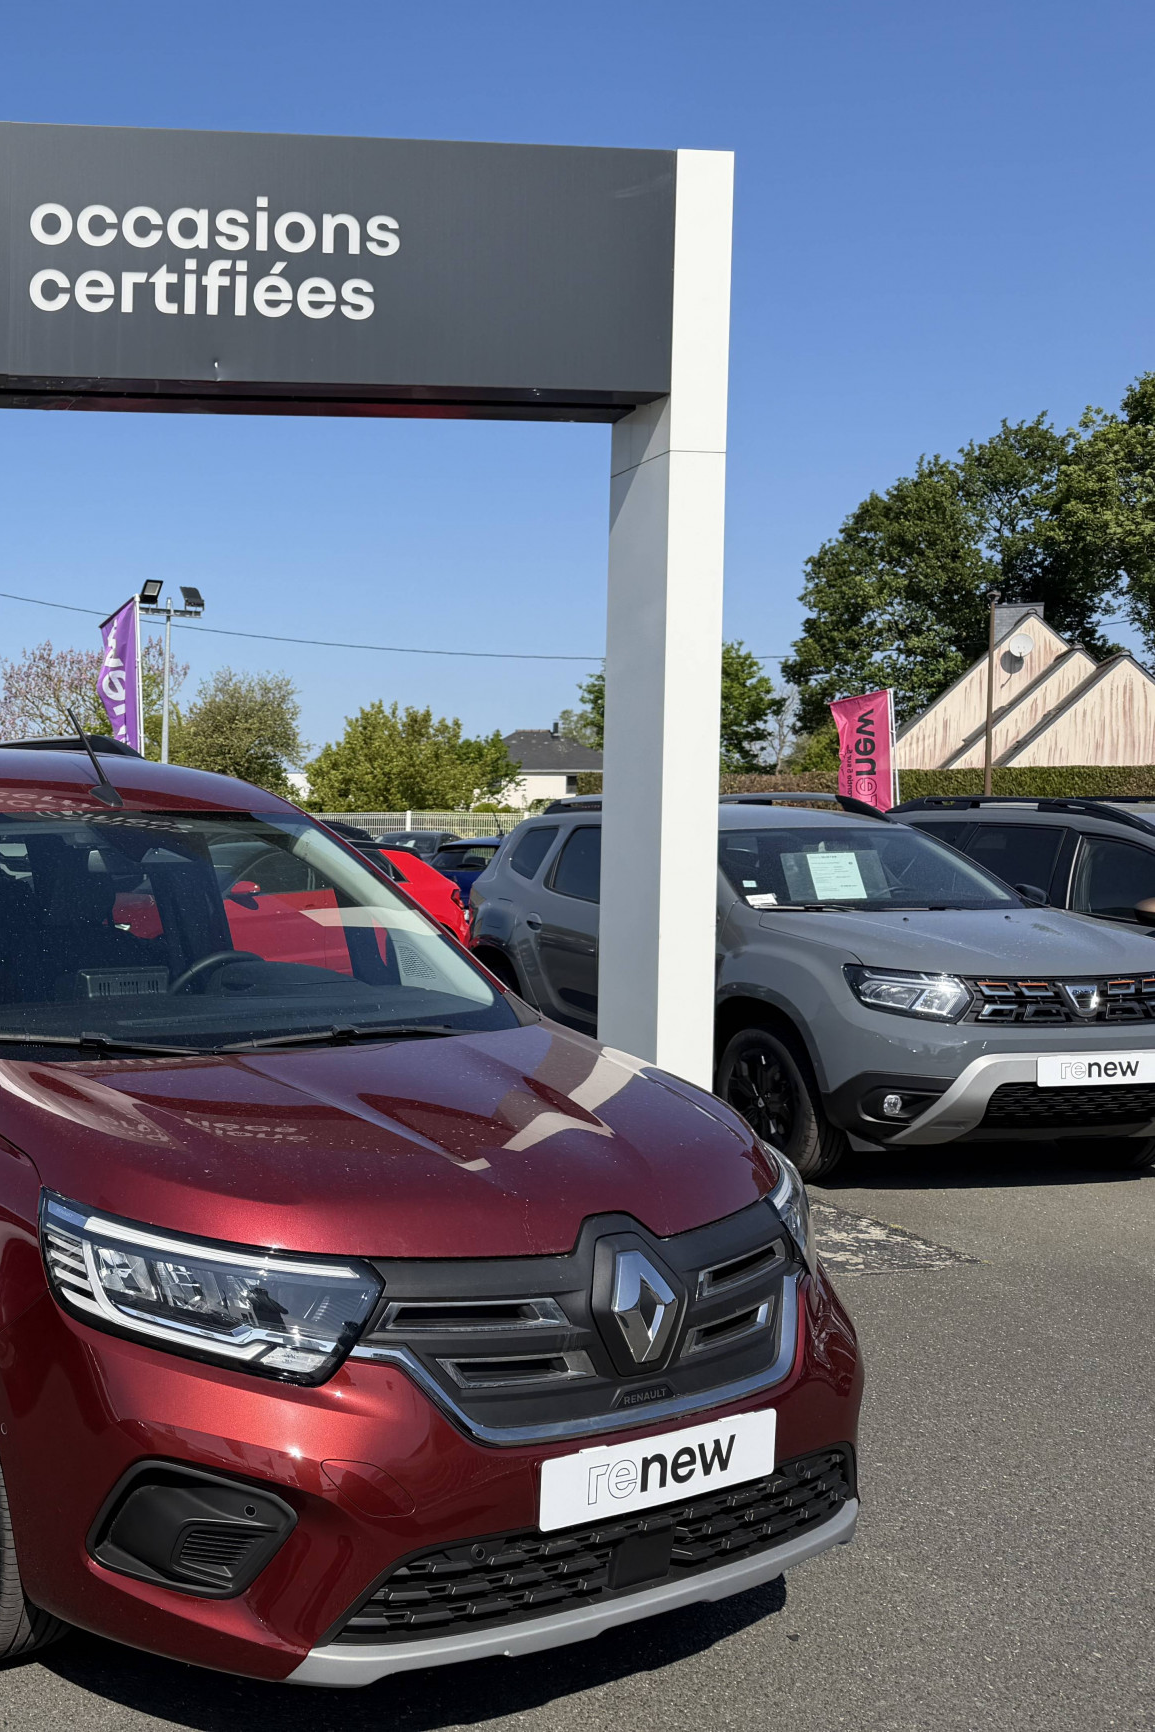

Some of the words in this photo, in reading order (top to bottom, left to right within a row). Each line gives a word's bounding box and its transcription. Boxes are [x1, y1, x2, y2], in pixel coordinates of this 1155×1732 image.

[29, 194, 402, 258] occasions
[29, 259, 376, 322] certifiées
[1060, 1060, 1140, 1080] renew
[624, 1388, 667, 1405] RENAULT
[586, 1433, 737, 1506] renew
